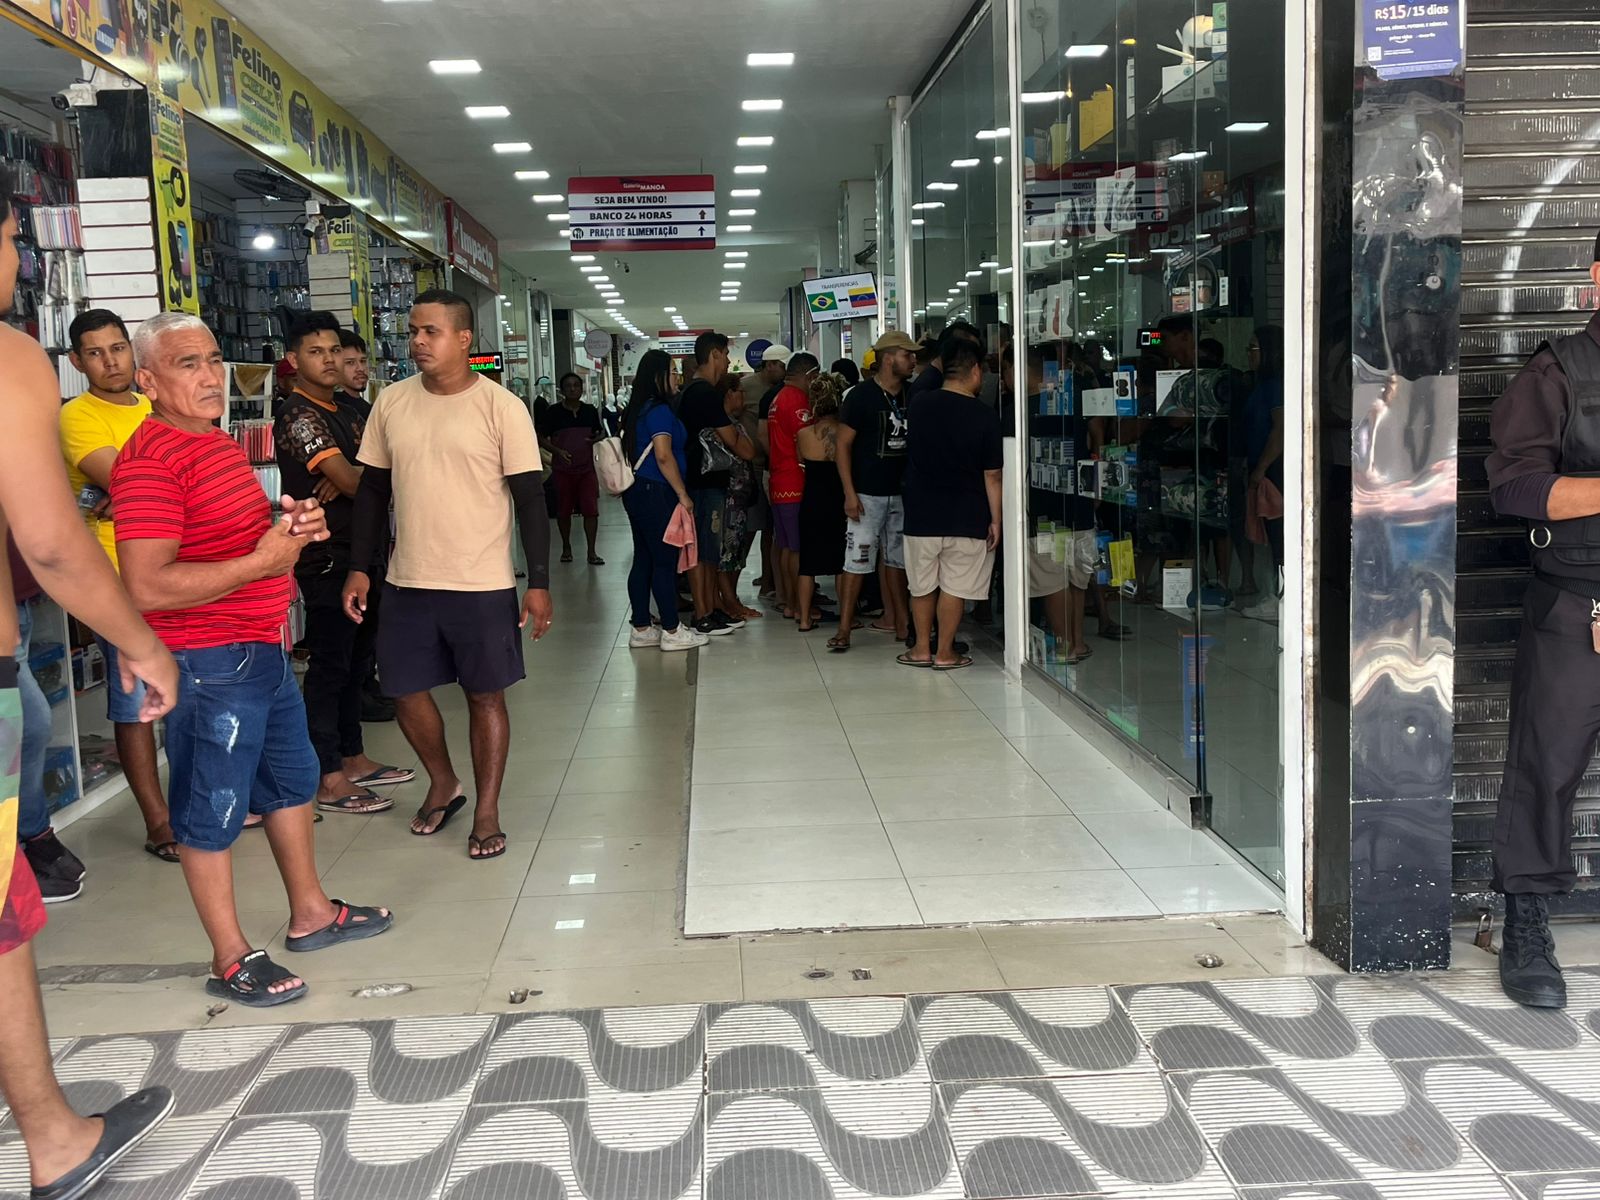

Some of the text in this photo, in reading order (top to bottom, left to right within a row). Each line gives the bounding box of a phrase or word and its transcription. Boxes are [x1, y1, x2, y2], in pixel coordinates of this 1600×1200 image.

[1427, 4, 1449, 16] dias
[79, 10, 92, 43] LG
[231, 31, 281, 91] Felino
[156, 98, 181, 125] Felino
[396, 163, 418, 192] Felino
[594, 195, 667, 205] SEJA BEM VINDO!
[589, 211, 673, 221] BANCO 24 HORAS
[327, 219, 354, 234] Feli
[589, 226, 679, 239] PRAÇA DE ALIMENTAÇÃO
[460, 222, 493, 271] Impacto
[304, 437, 323, 454] FLN
